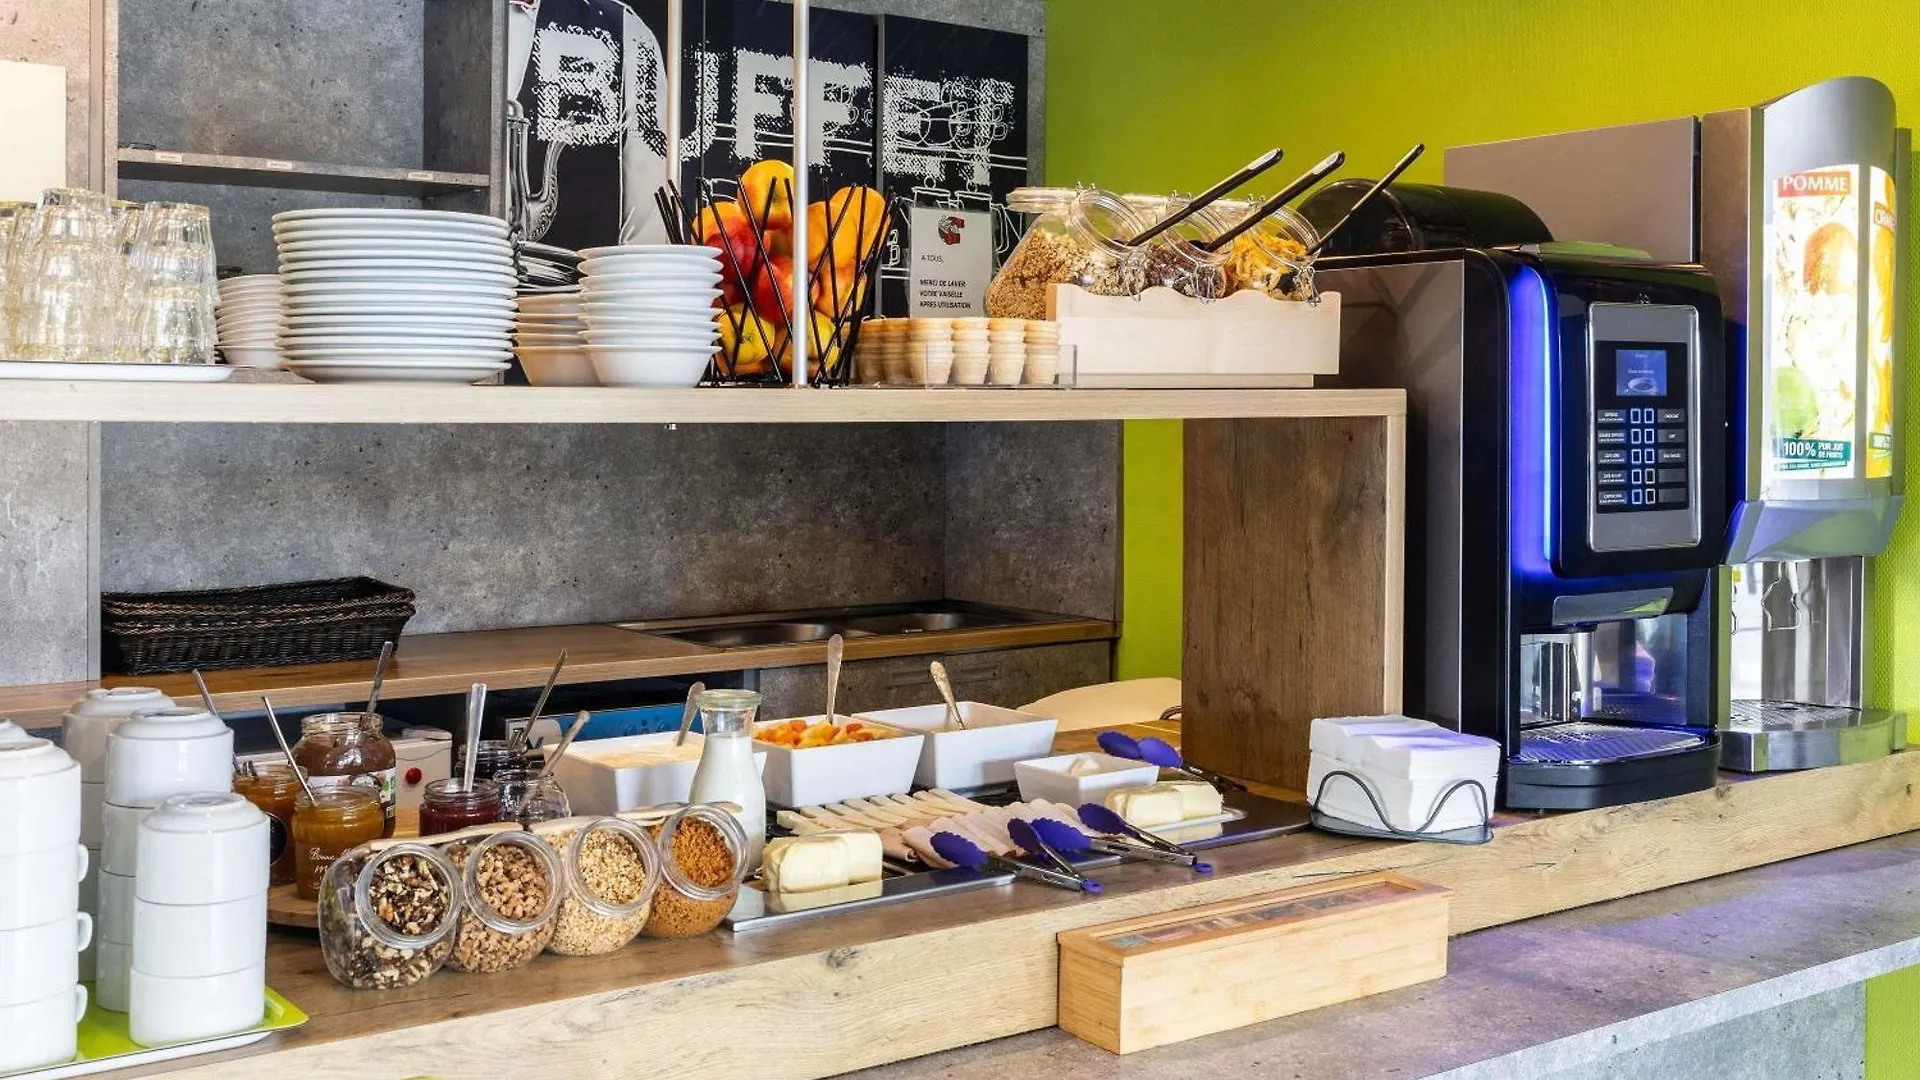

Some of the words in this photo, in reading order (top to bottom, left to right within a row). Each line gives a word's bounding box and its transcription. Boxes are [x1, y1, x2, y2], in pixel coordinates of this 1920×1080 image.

[535, 24, 1014, 185] BUFFET
[1782, 175, 1848, 192] POMME
[920, 279, 938, 287] MERCI
